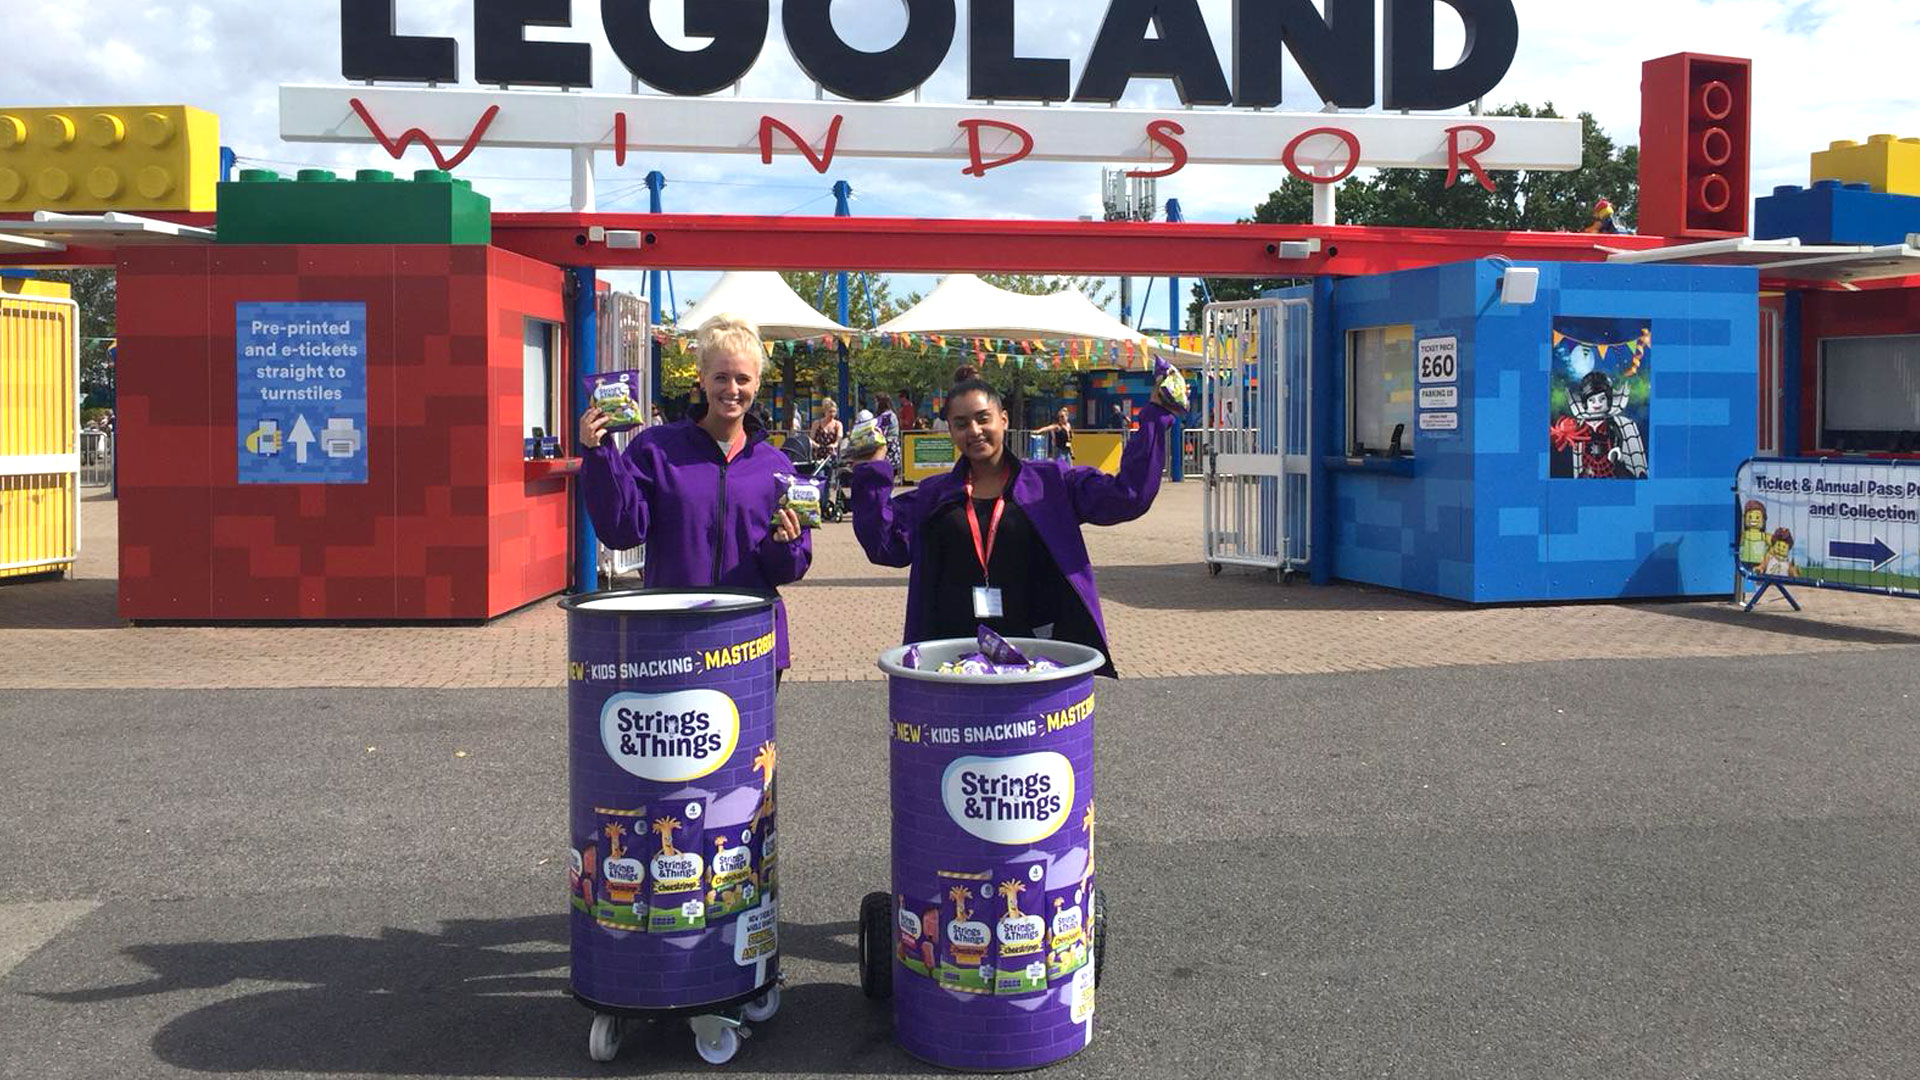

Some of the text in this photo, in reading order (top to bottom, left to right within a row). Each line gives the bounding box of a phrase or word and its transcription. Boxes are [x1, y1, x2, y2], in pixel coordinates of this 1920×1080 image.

[350, 97, 1497, 191] WINDSOR
[251, 320, 350, 338] Pre-printed
[244, 342, 358, 357] and e-tickets
[256, 363, 346, 382] straight to
[1422, 354, 1454, 378] £60
[260, 385, 342, 400] turnstiles
[1755, 475, 1798, 491] Ticket
[1801, 477, 1812, 492] &
[1815, 478, 1863, 494] Annual
[1867, 481, 1905, 496] Pass
[1809, 502, 1916, 521] and Collection
[591, 663, 617, 680] KIDS
[619, 656, 693, 679] SNACKING
[617, 707, 710, 737] Strings
[896, 722, 921, 743] NEW
[931, 727, 960, 744] KIDS
[963, 720, 1036, 743] SNACKING
[620, 731, 722, 759] &Things
[961, 771, 1051, 799] Strings
[964, 793, 1061, 821] &Things
[658, 860, 693, 872] Strings
[658, 867, 697, 879] &Things
[1003, 923, 1036, 935] Strings
